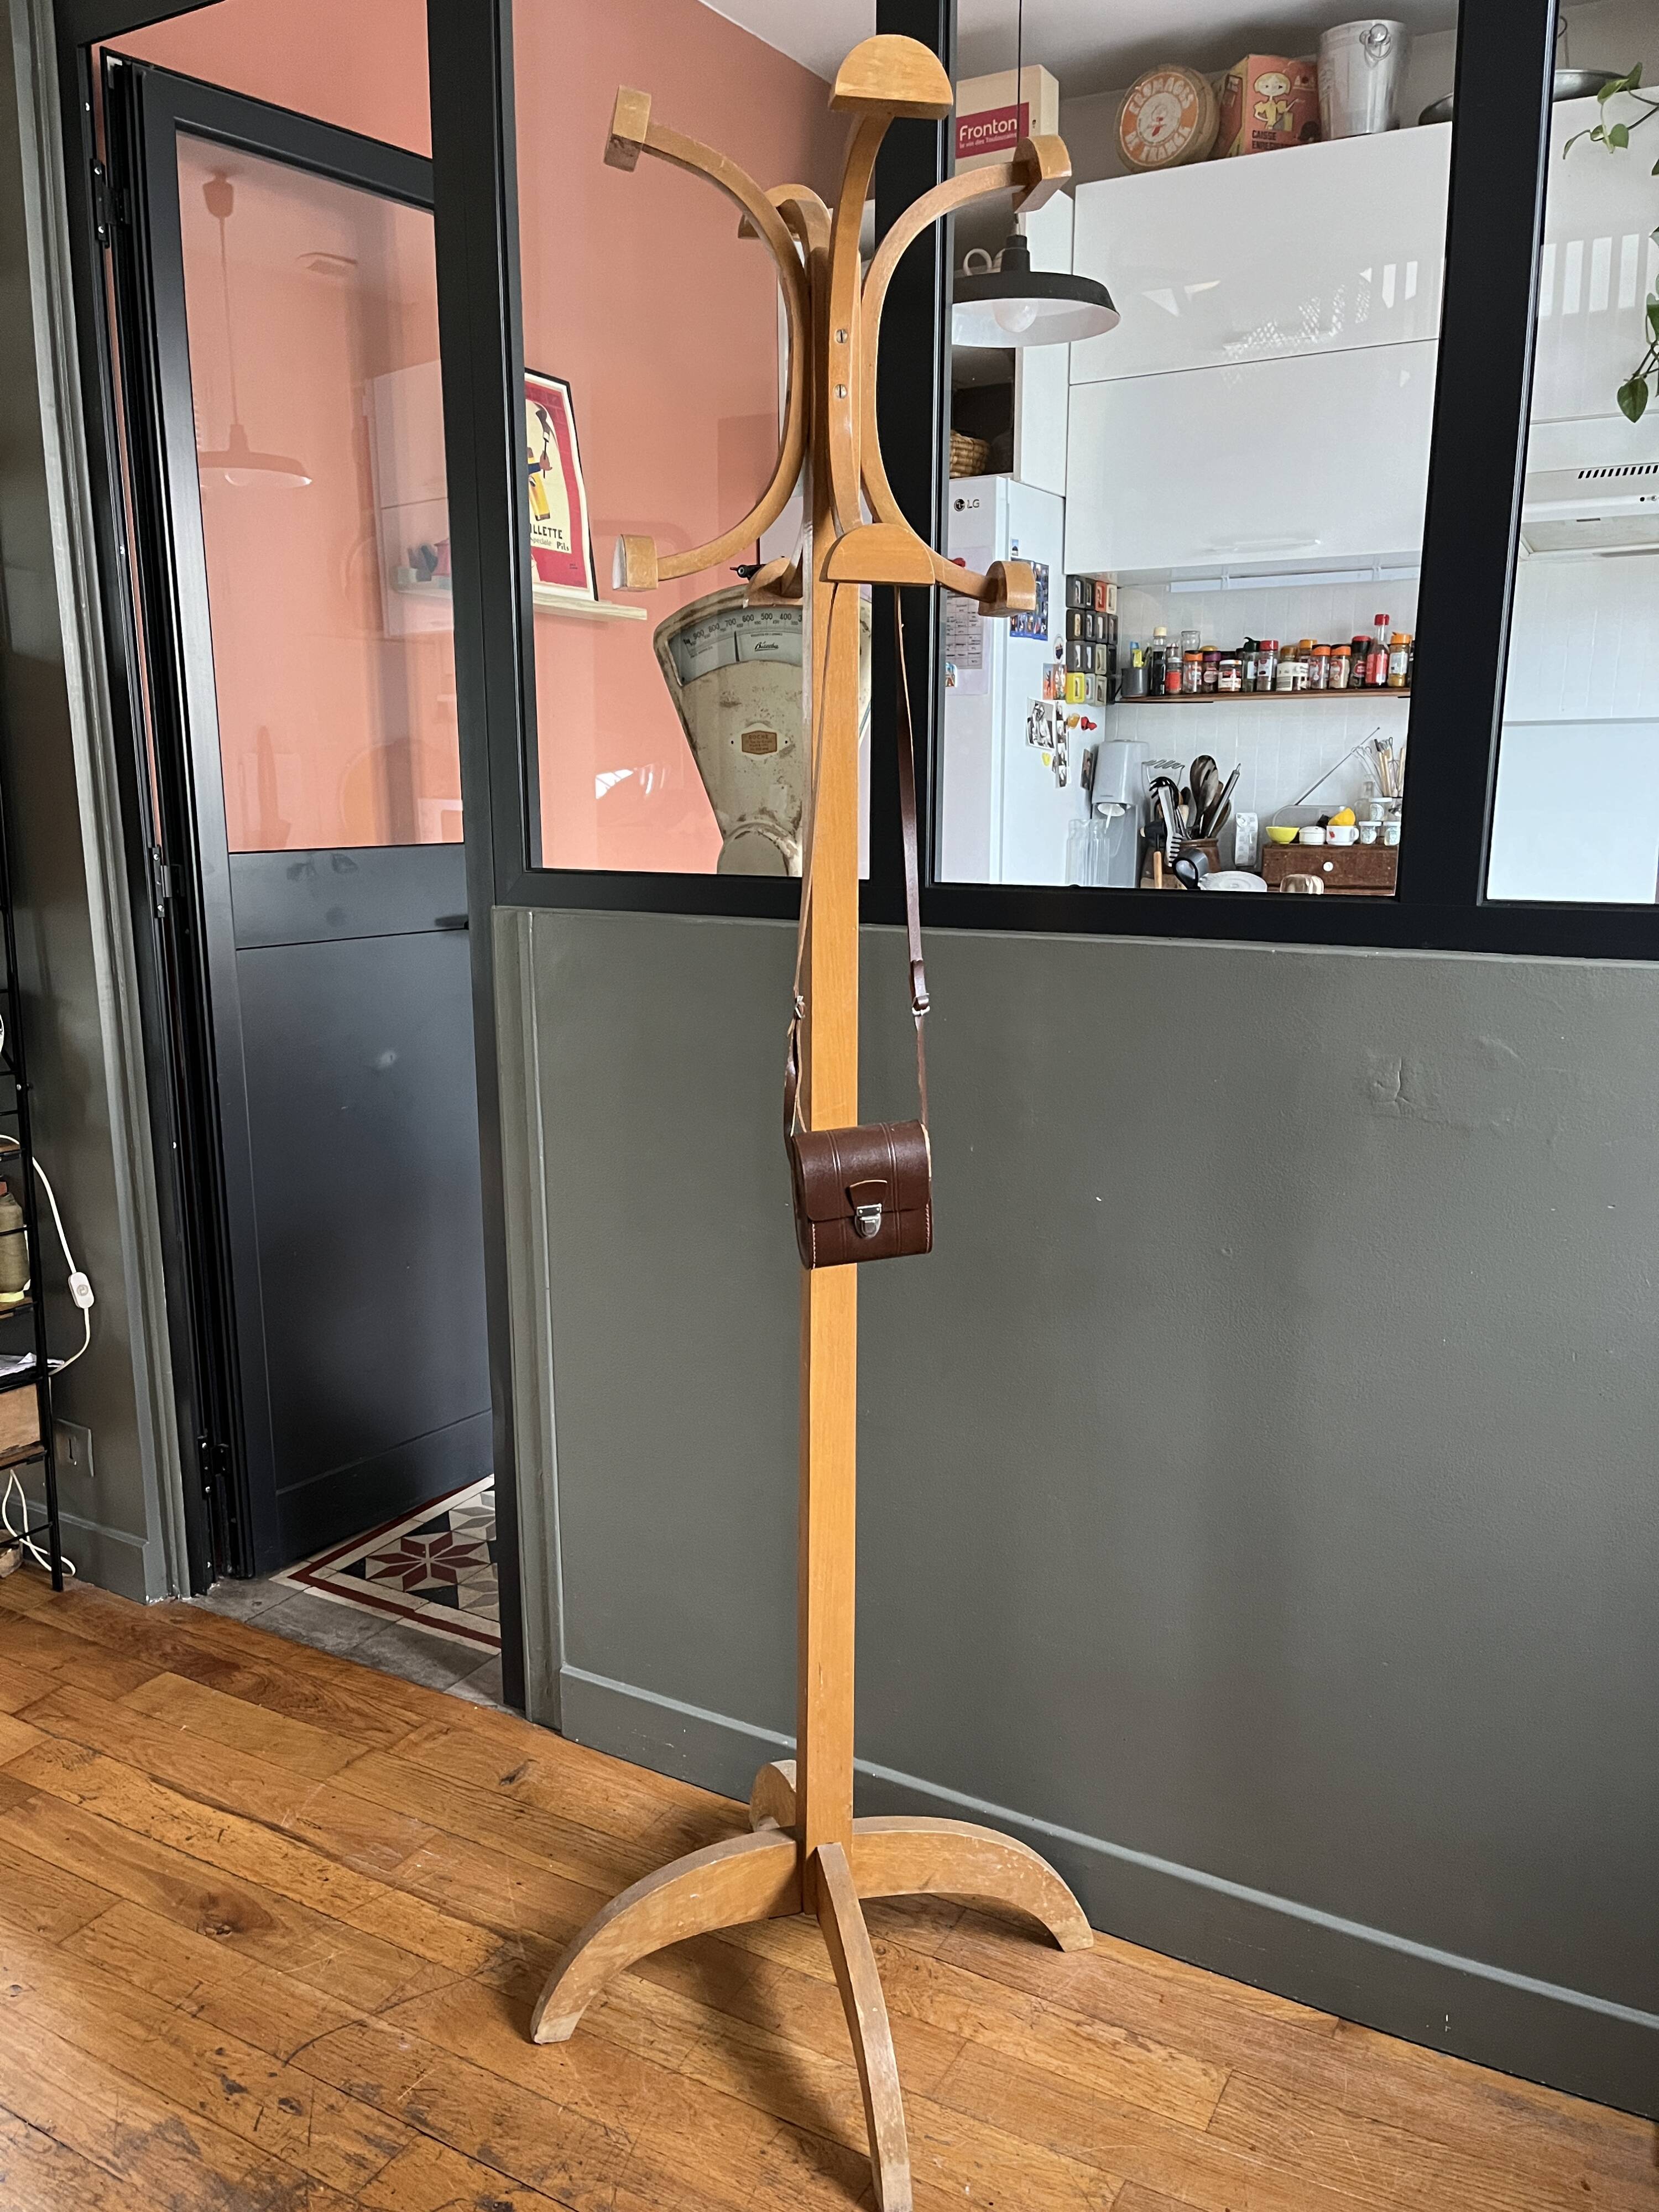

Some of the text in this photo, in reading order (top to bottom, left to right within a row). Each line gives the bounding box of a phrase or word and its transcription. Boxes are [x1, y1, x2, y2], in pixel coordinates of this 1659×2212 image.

[959, 118, 1017, 142] Fronton
[1252, 130, 1277, 140] CAISSE
[967, 499, 979, 509] LG
[556, 541, 570, 551] Pils
[693, 629, 705, 640] 900
[708, 623, 719, 633] 800
[724, 618, 736, 627] 700
[742, 614, 754, 623] 600
